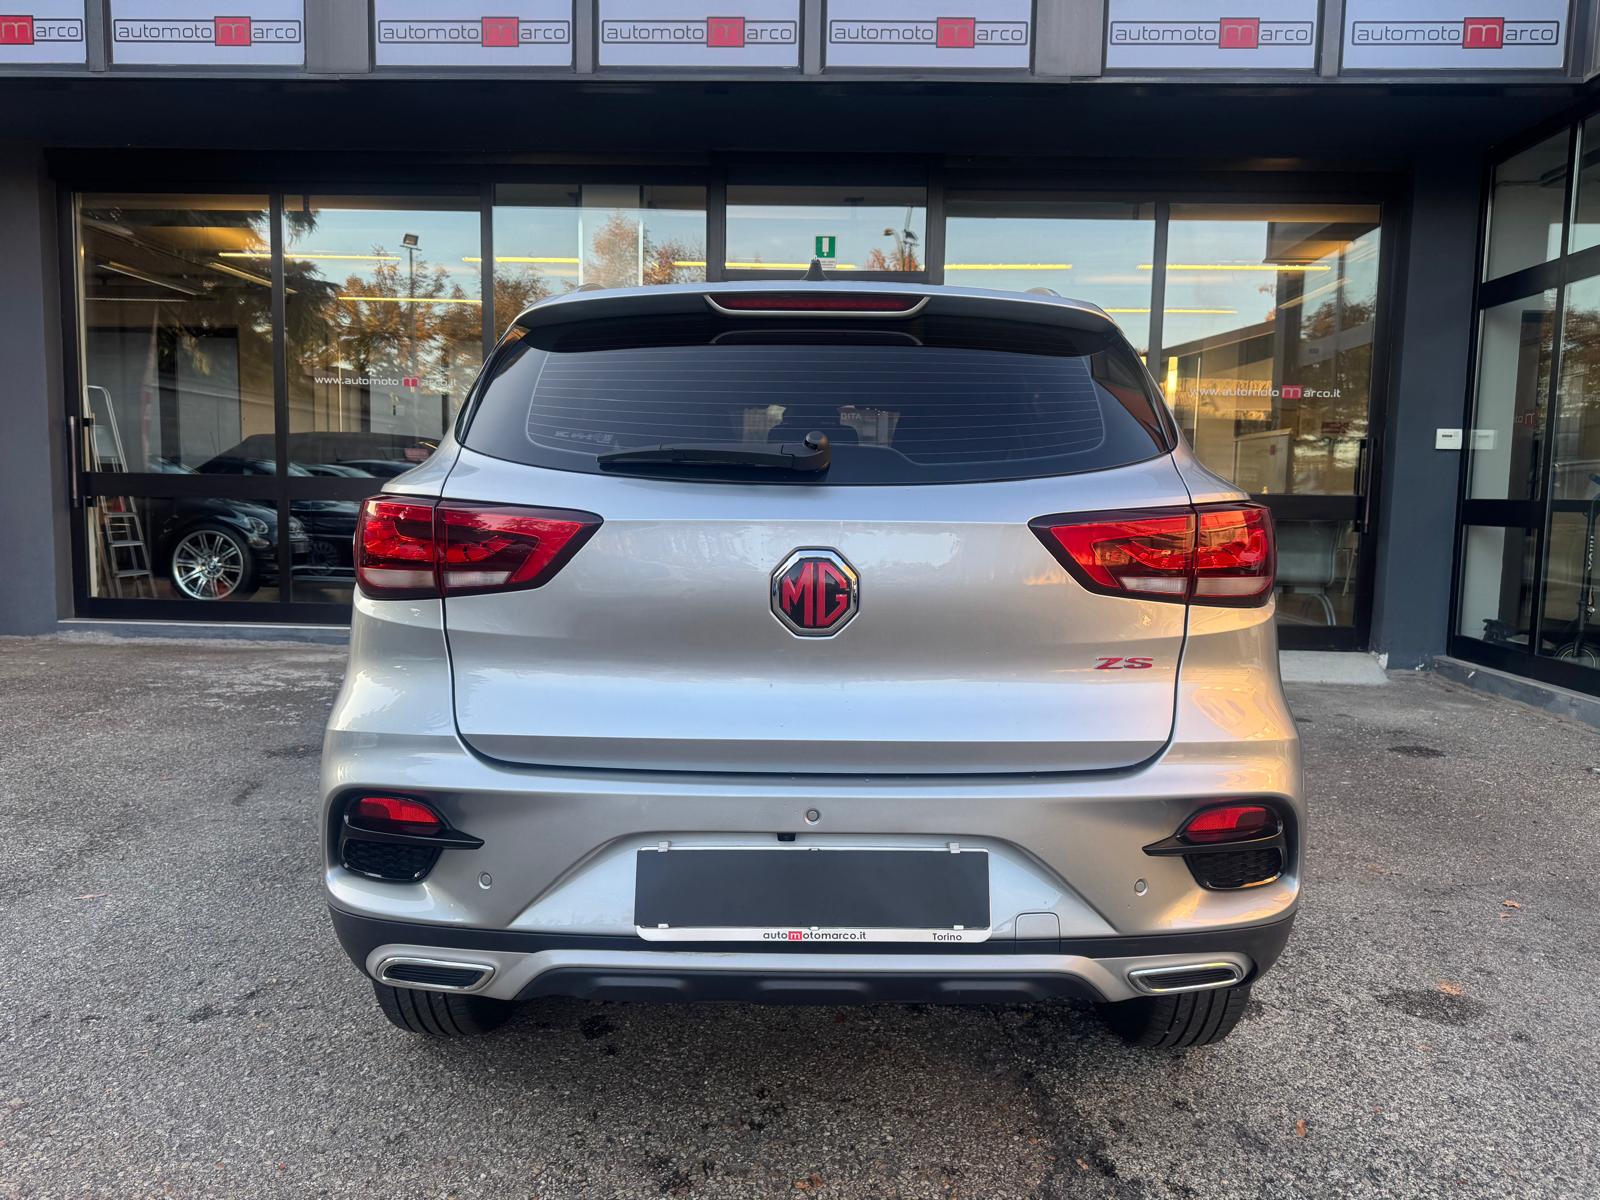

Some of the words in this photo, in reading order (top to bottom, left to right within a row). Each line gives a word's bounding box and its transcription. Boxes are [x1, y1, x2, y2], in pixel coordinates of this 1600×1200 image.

[782, 561, 848, 627] MG
[1094, 657, 1154, 670] ZS
[763, 930, 867, 941] automotomarco.it
[932, 932, 963, 941] Torino
